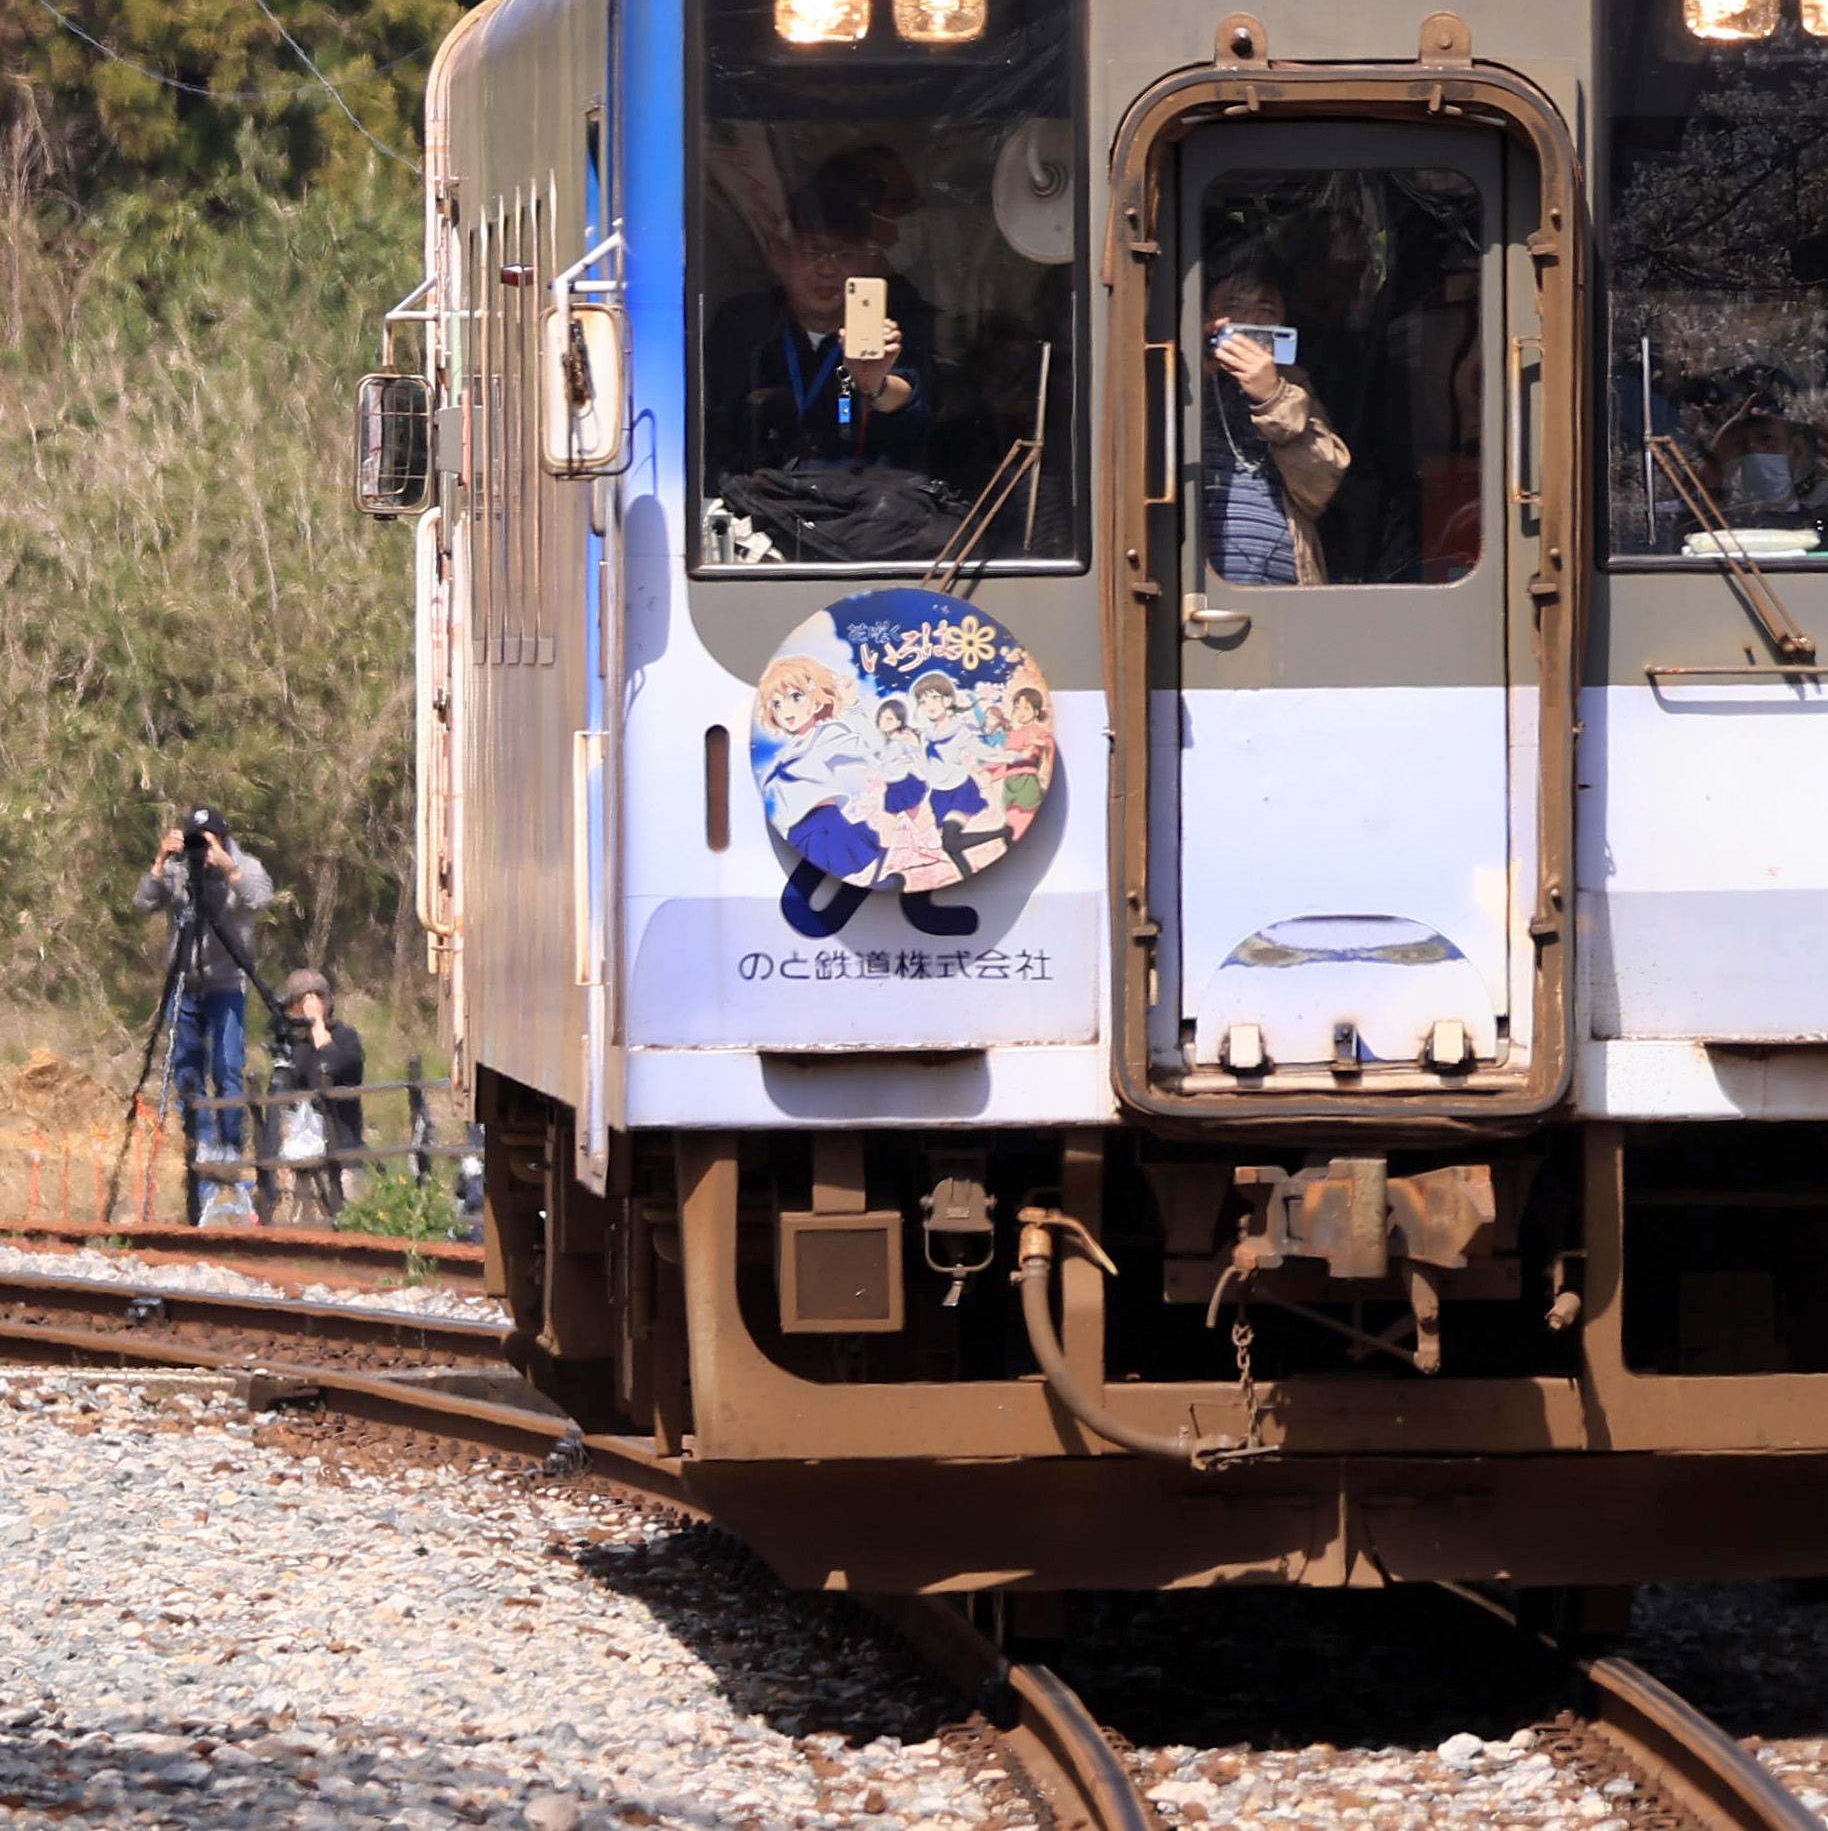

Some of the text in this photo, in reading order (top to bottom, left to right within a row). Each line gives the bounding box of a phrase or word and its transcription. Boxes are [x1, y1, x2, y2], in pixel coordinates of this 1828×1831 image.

[860, 618, 964, 673] いろは
[738, 948, 1054, 981] のと鉄道株式会社
